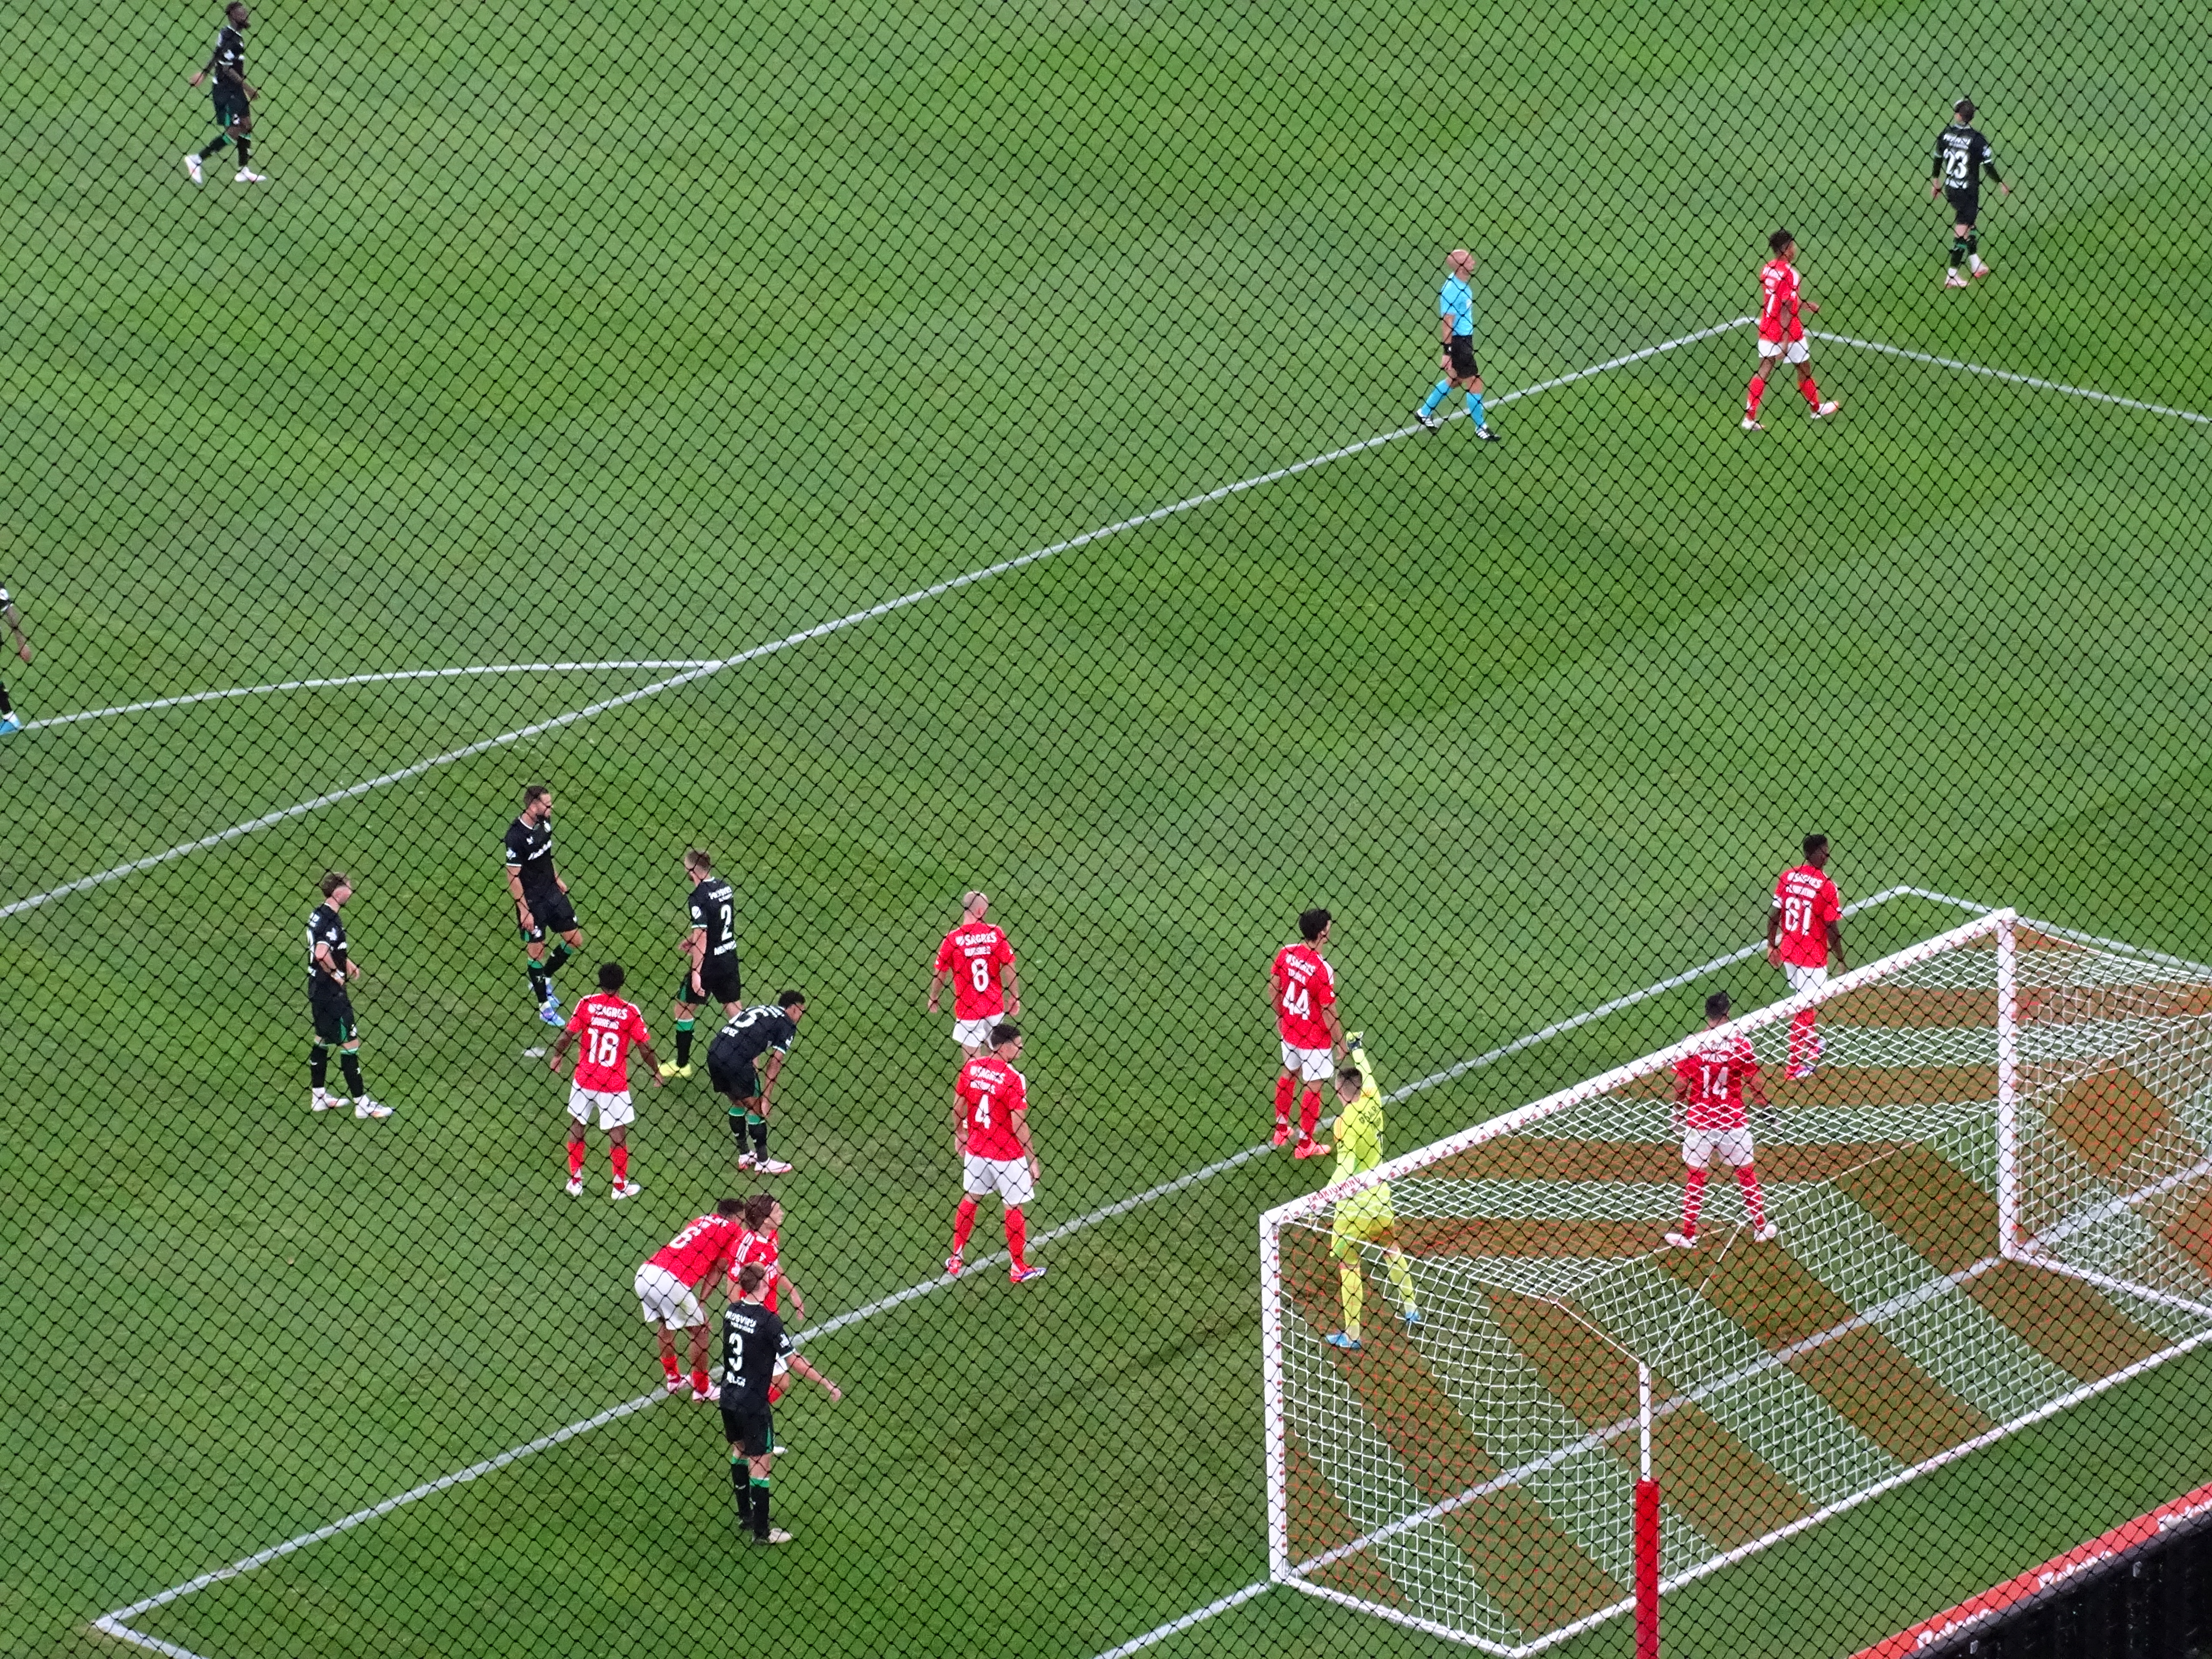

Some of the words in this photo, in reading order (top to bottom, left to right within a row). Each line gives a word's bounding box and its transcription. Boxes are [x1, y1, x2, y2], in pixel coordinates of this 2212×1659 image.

[1943, 149, 1968, 178] 23
[721, 905, 732, 941] 2
[1785, 897, 1811, 936] 61
[965, 932, 997, 946] SAGRES
[596, 1004, 628, 1020] SAGRES
[1283, 981, 1310, 1020] 44
[588, 1028, 620, 1067] 18
[1700, 1065, 1728, 1100] 14
[975, 1094, 990, 1129] 4
[729, 1333, 743, 1371] 3
